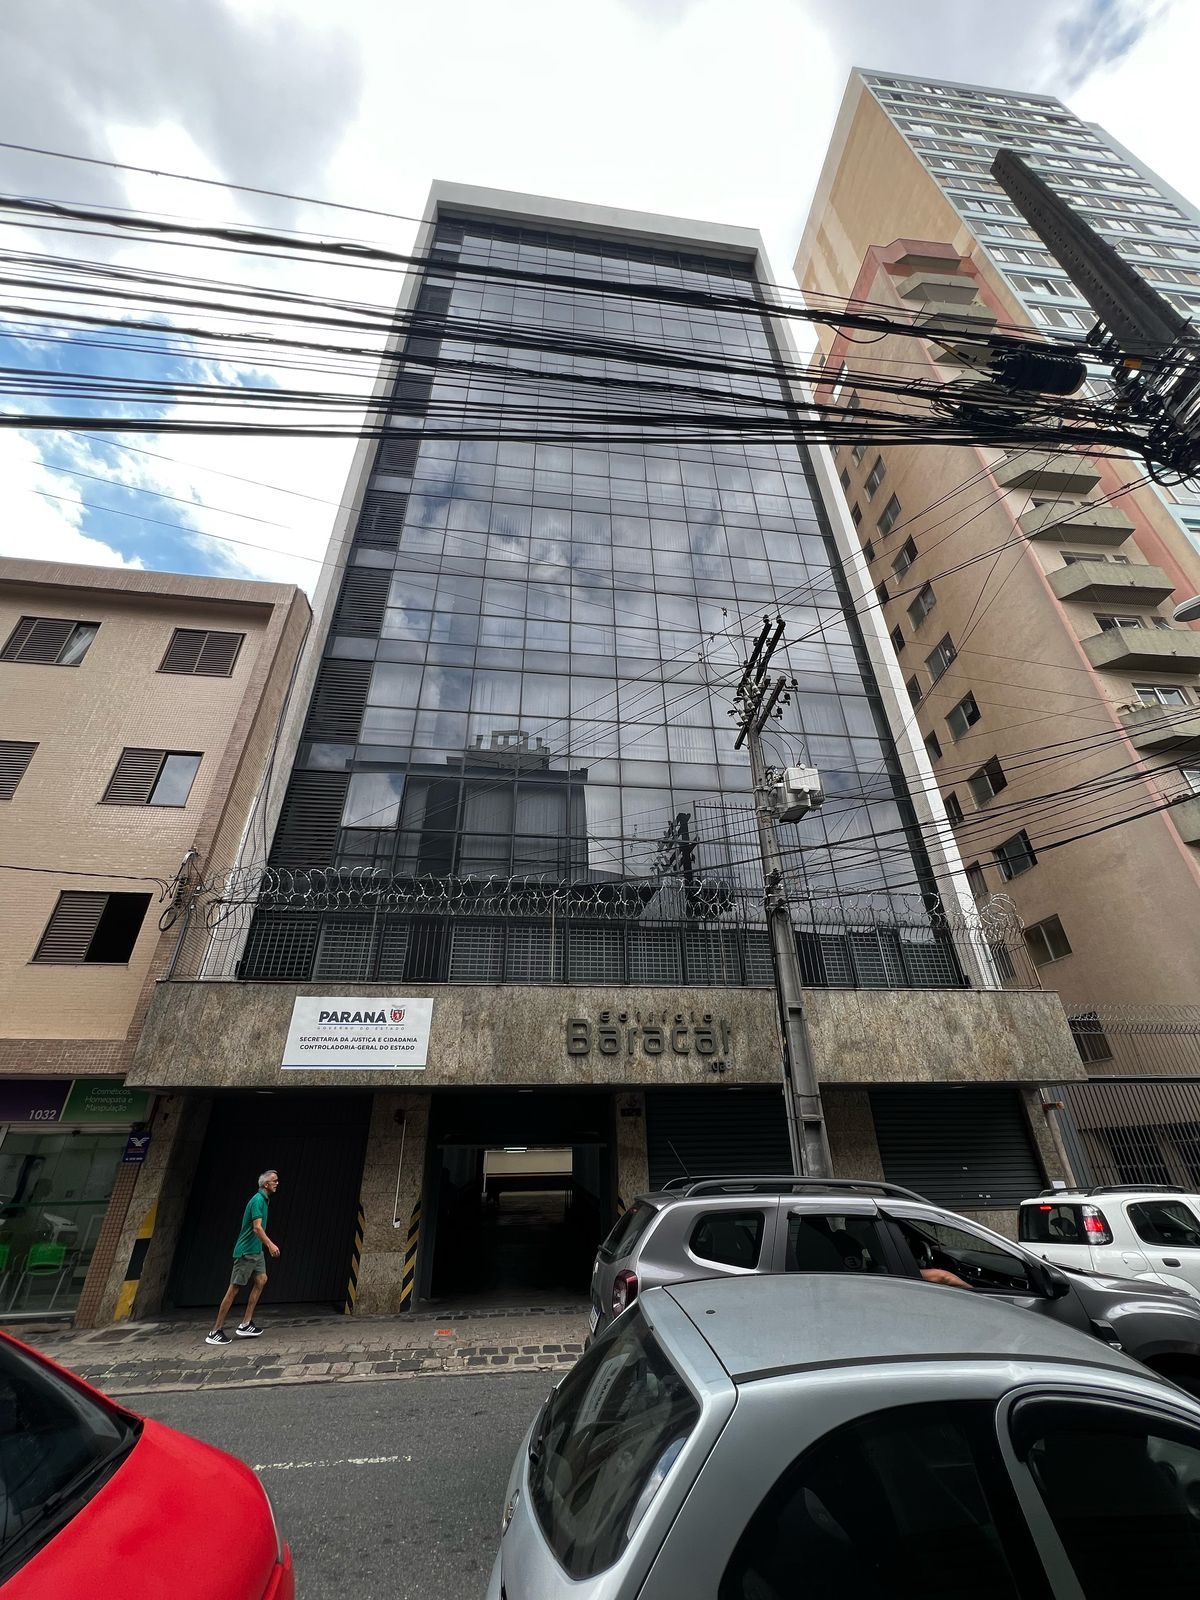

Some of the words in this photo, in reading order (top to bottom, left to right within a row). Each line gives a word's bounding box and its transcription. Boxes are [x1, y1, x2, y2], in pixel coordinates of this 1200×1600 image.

[318, 1010, 387, 1023] PARANÁ
[567, 1018, 732, 1054] Baracat
[29, 1109, 57, 1120] 1032
